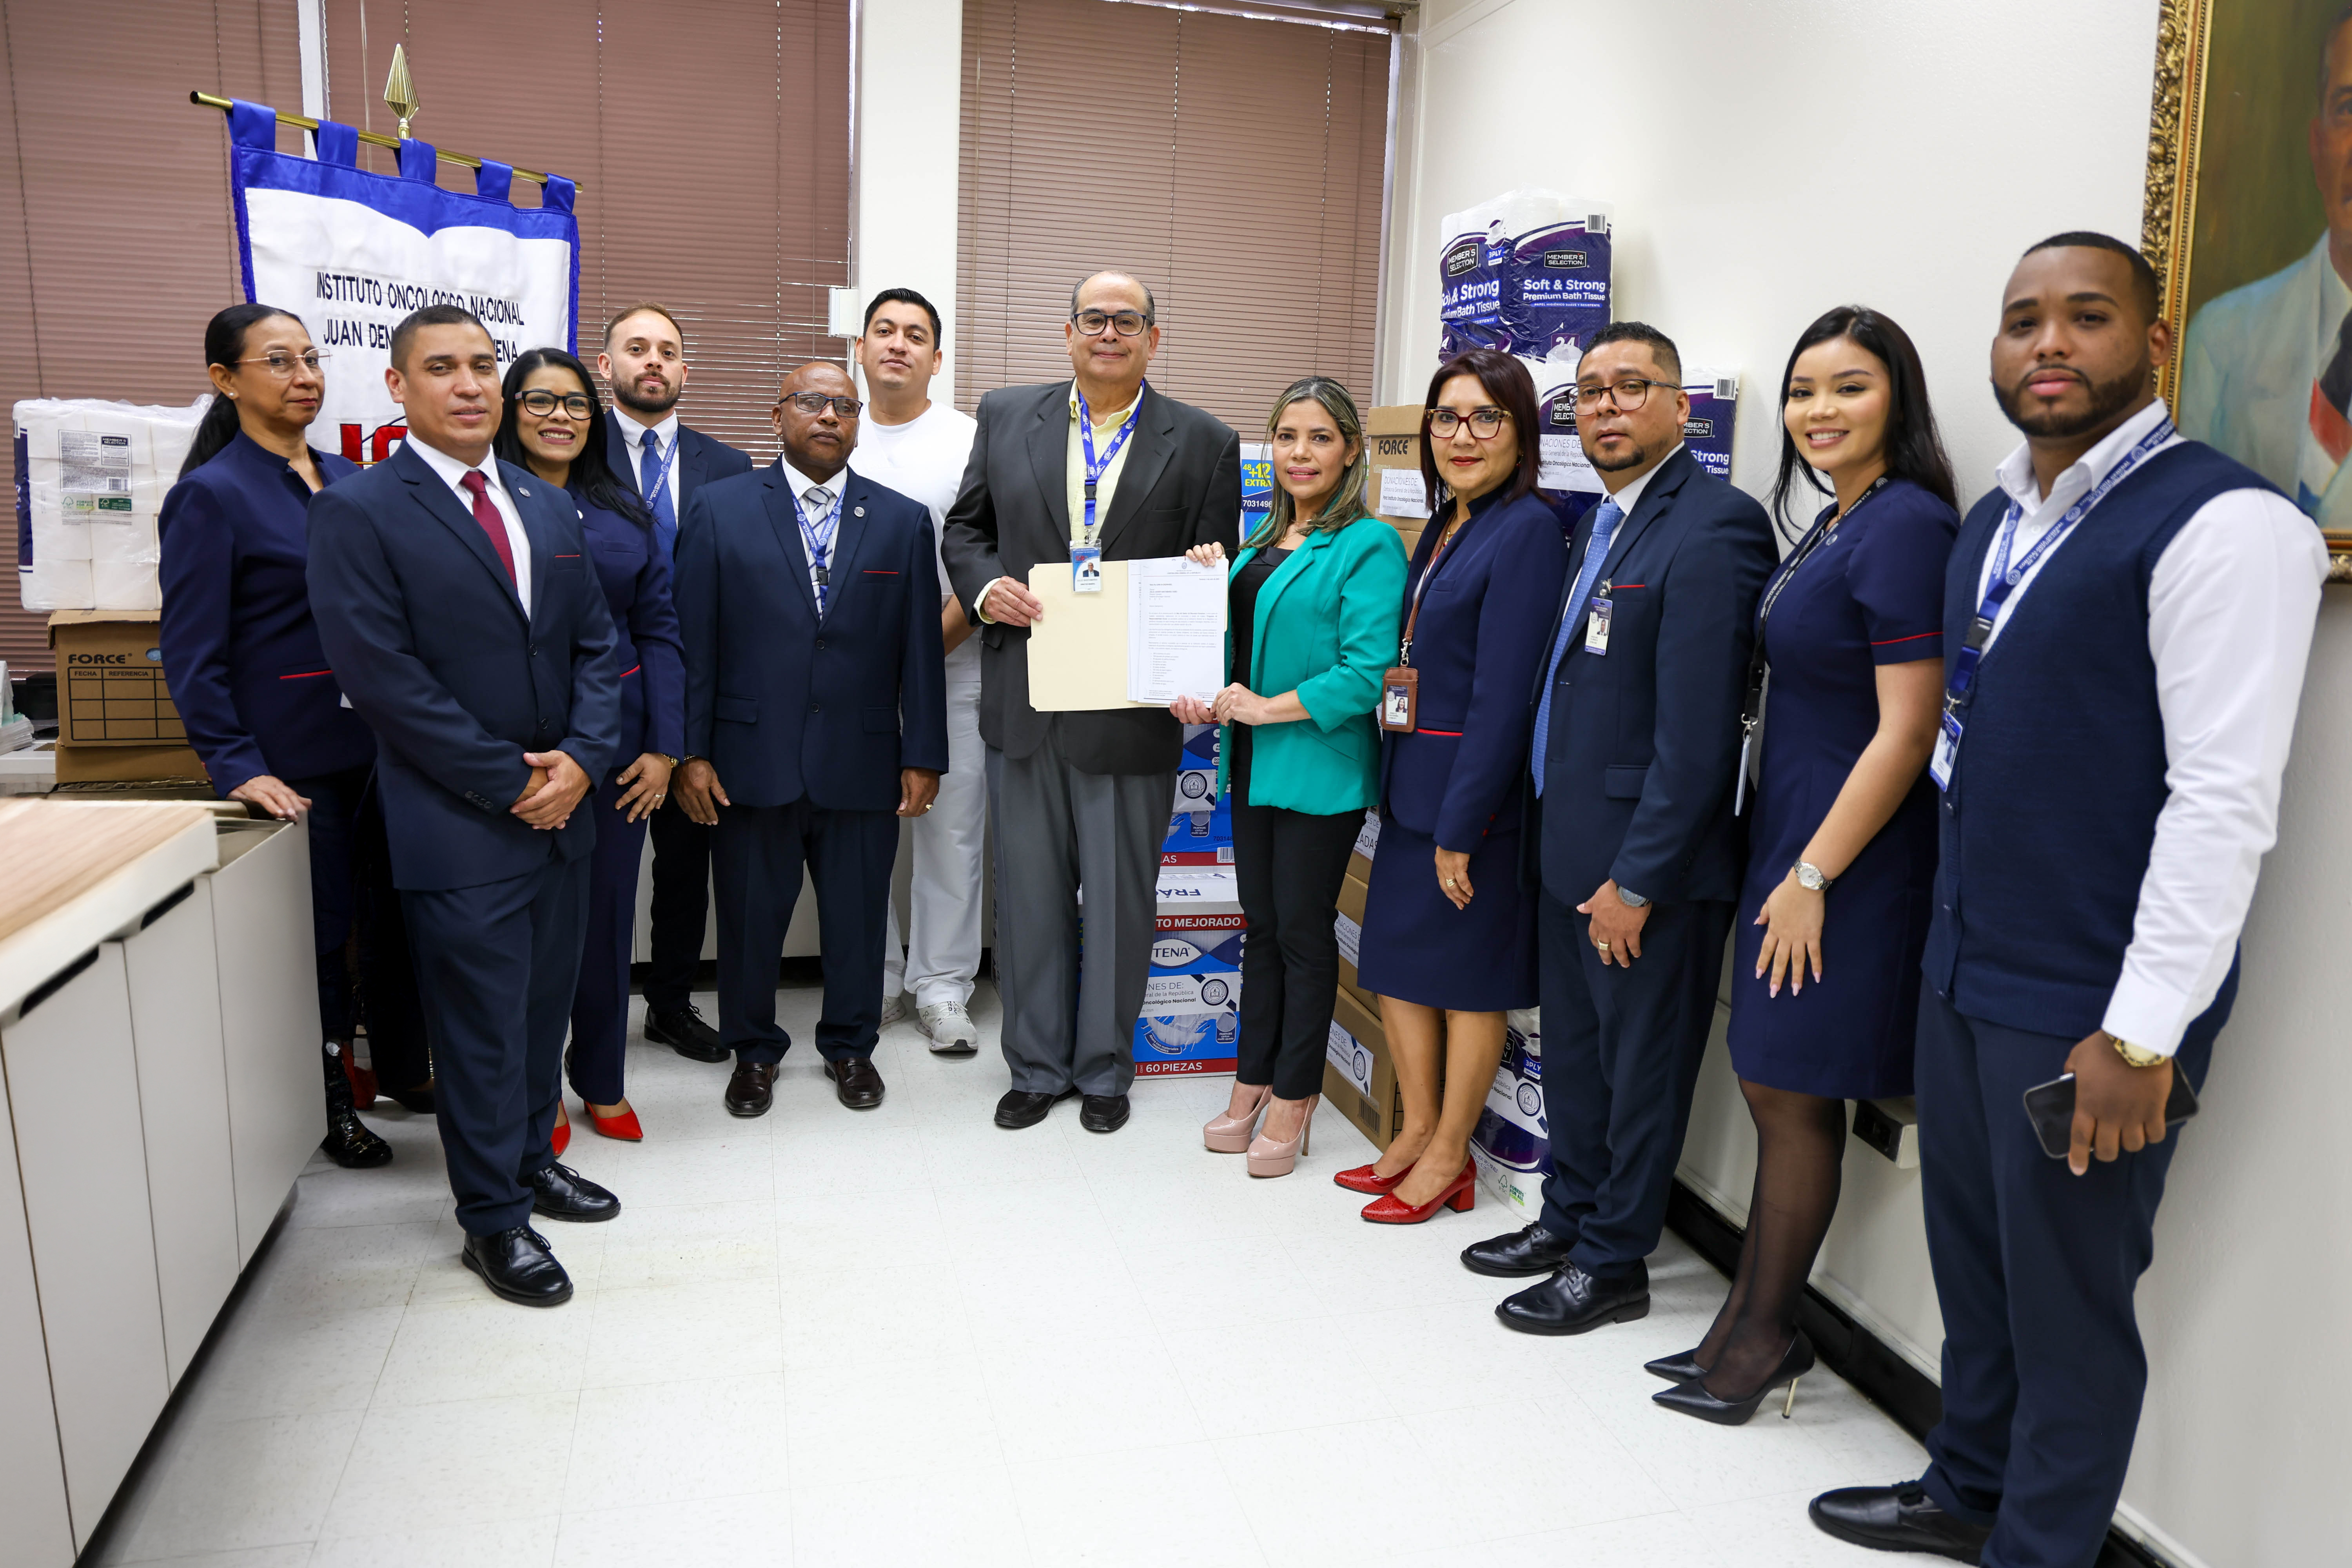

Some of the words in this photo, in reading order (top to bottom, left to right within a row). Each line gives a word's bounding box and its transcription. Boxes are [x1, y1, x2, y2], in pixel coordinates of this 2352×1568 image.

[1448, 248, 1475, 265] MEMBER'S
[1488, 249, 1502, 258] 3PLY
[1450, 258, 1474, 271] SELECTION
[1460, 280, 1499, 301] Strong
[1524, 279, 1550, 290] Soft
[1553, 279, 1563, 290] &
[1566, 279, 1606, 292] Strong
[317, 271, 381, 306] INSTITUTO
[470, 295, 524, 325] NACIONAL
[1583, 292, 1605, 301] Tissue
[1457, 303, 1475, 318] Bath
[1476, 300, 1500, 314] Tissue
[323, 319, 362, 347] JUAN
[1378, 439, 1408, 455] FORCE
[1706, 465, 1729, 474] Tissue
[1245, 479, 1272, 487] EXTRA
[1384, 476, 1410, 486] DONACIONES
[68, 654, 125, 664] FORCE
[1156, 889, 1201, 898] FRÁ
[1174, 917, 1241, 927] MEJORADO
[1153, 947, 1189, 958] TENA
[1152, 1043, 1169, 1053] respirables
[1146, 1064, 1160, 1073] 60
[1163, 1062, 1202, 1072] PIEZAS
[1526, 1060, 1541, 1071] 3PLY
[1494, 1086, 1512, 1100] Nacional
[1510, 1184, 1524, 1197] FORESTS
